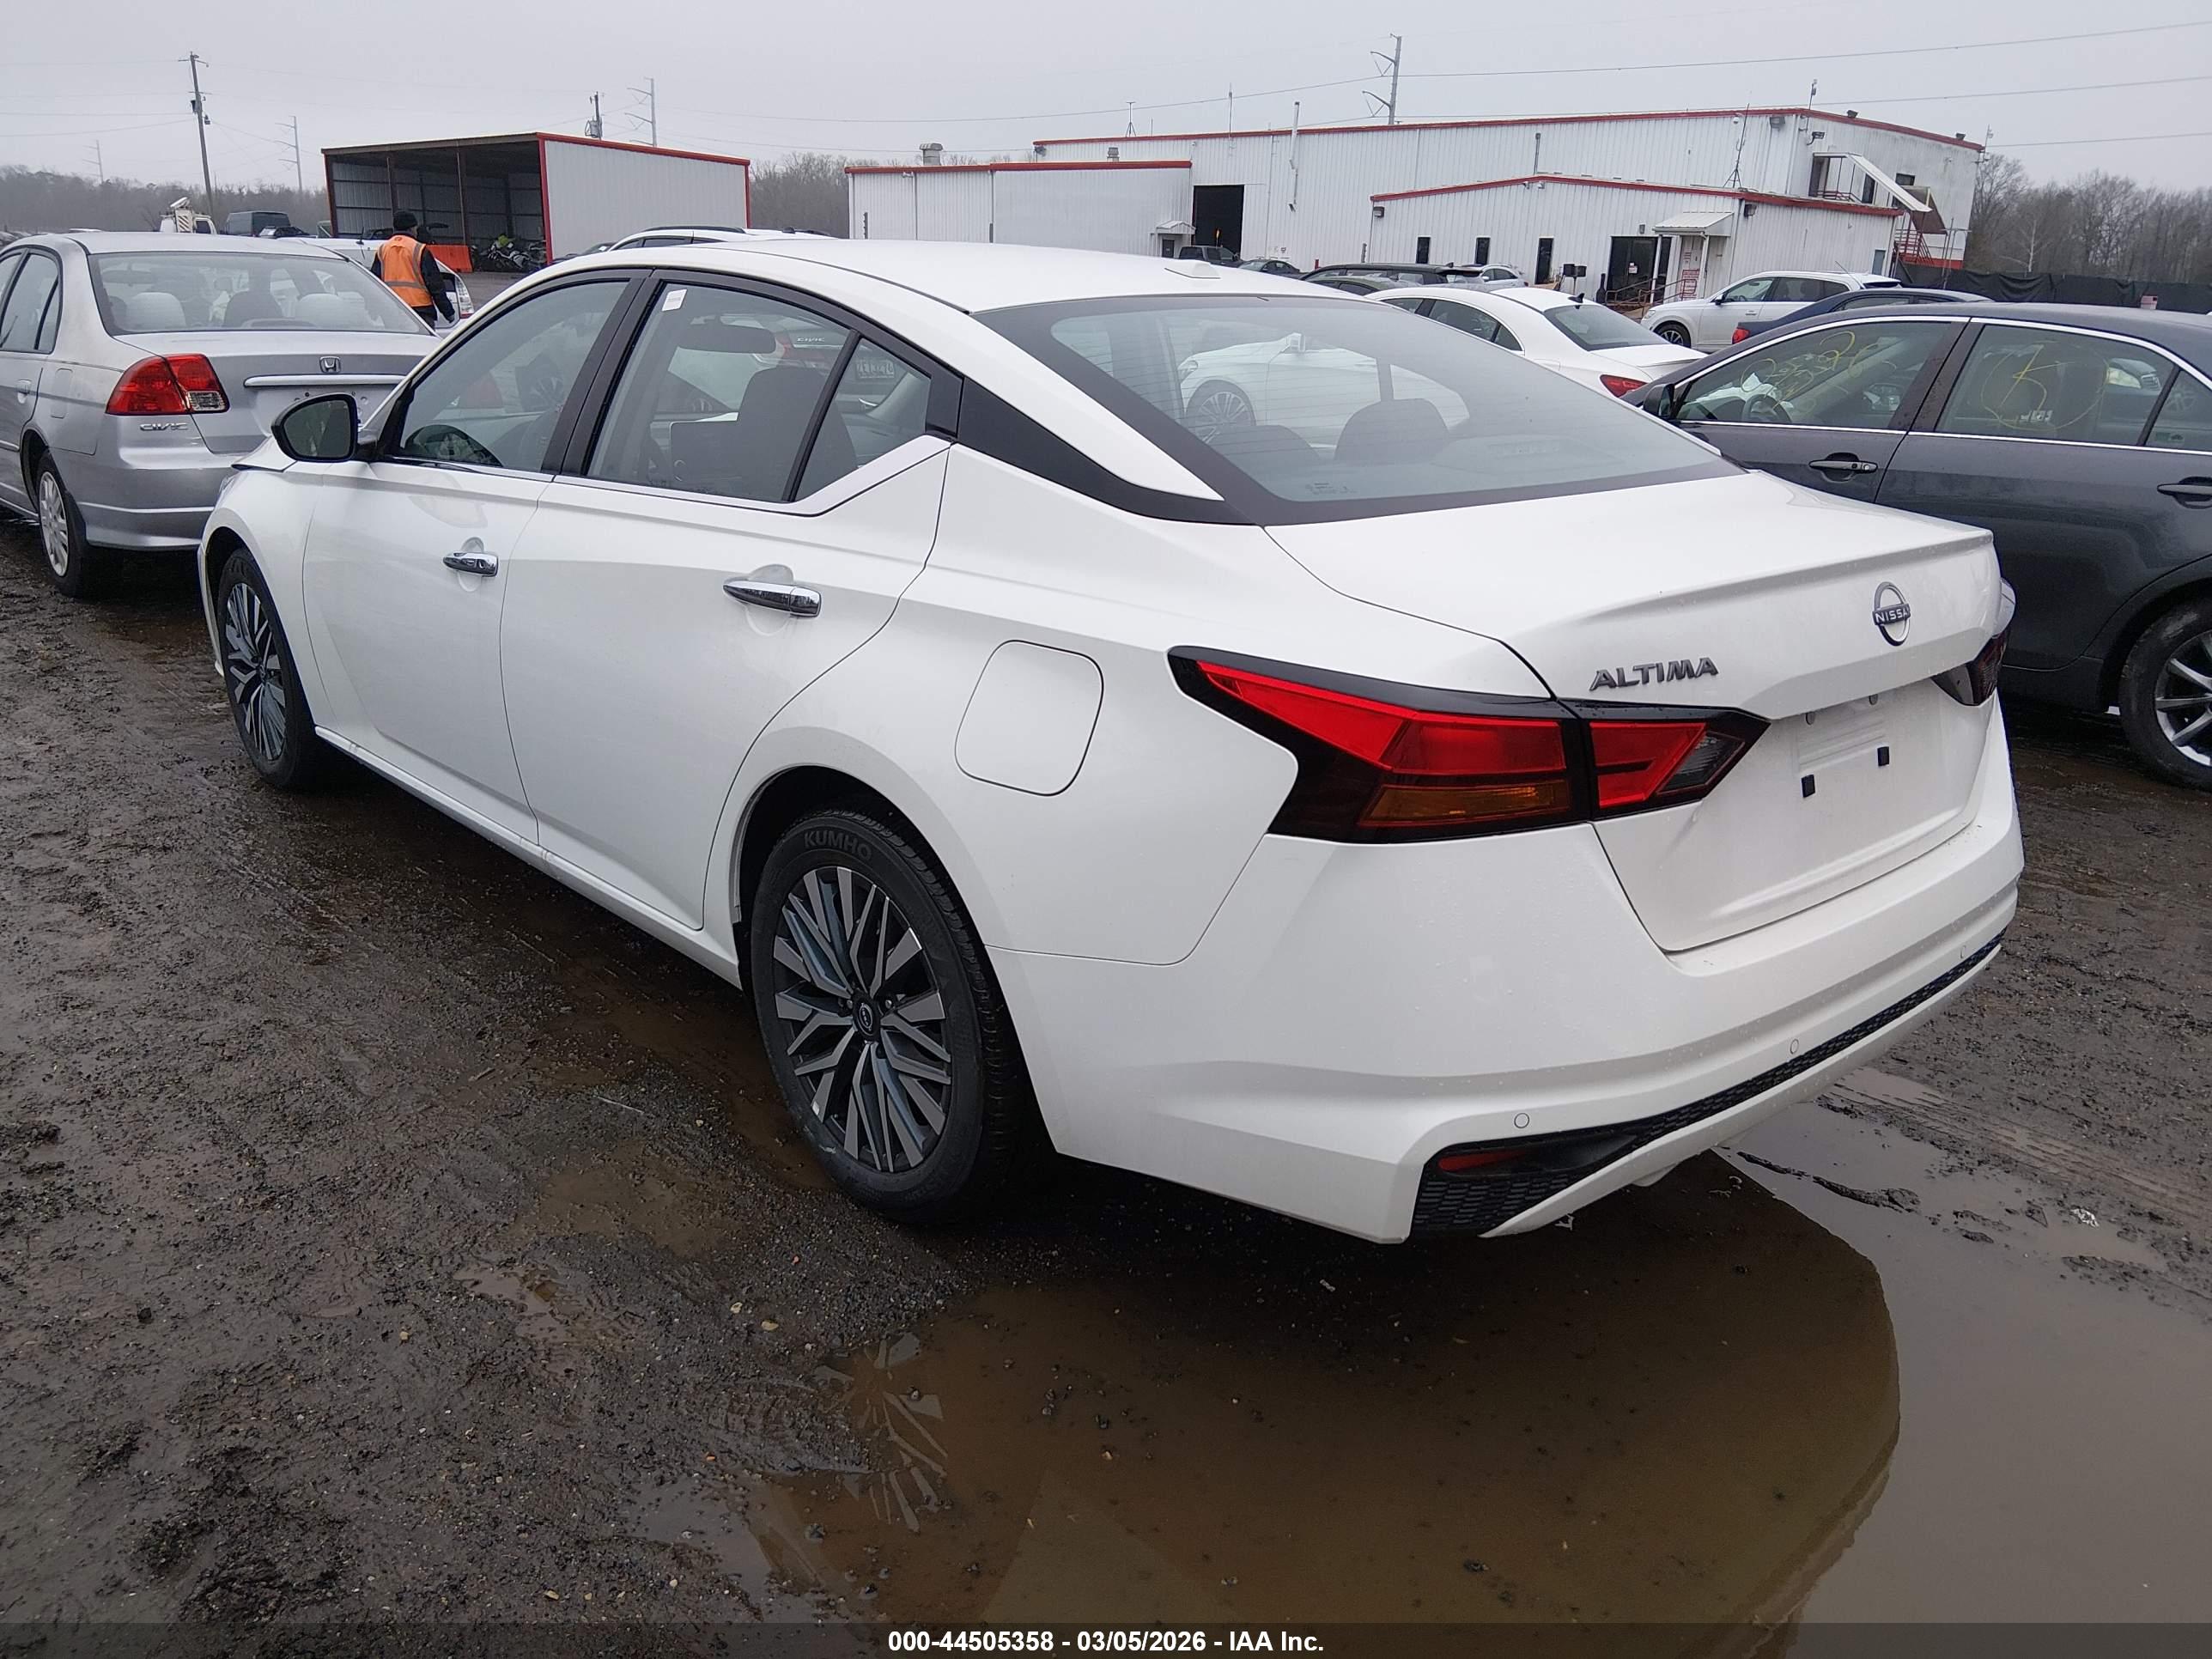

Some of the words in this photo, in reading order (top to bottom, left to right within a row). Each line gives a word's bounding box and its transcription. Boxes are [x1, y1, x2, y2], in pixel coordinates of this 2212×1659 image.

[141, 422, 187, 431] CIVIC
[1589, 657, 1720, 691] ALTIMA
[805, 830, 872, 860] KUMHO
